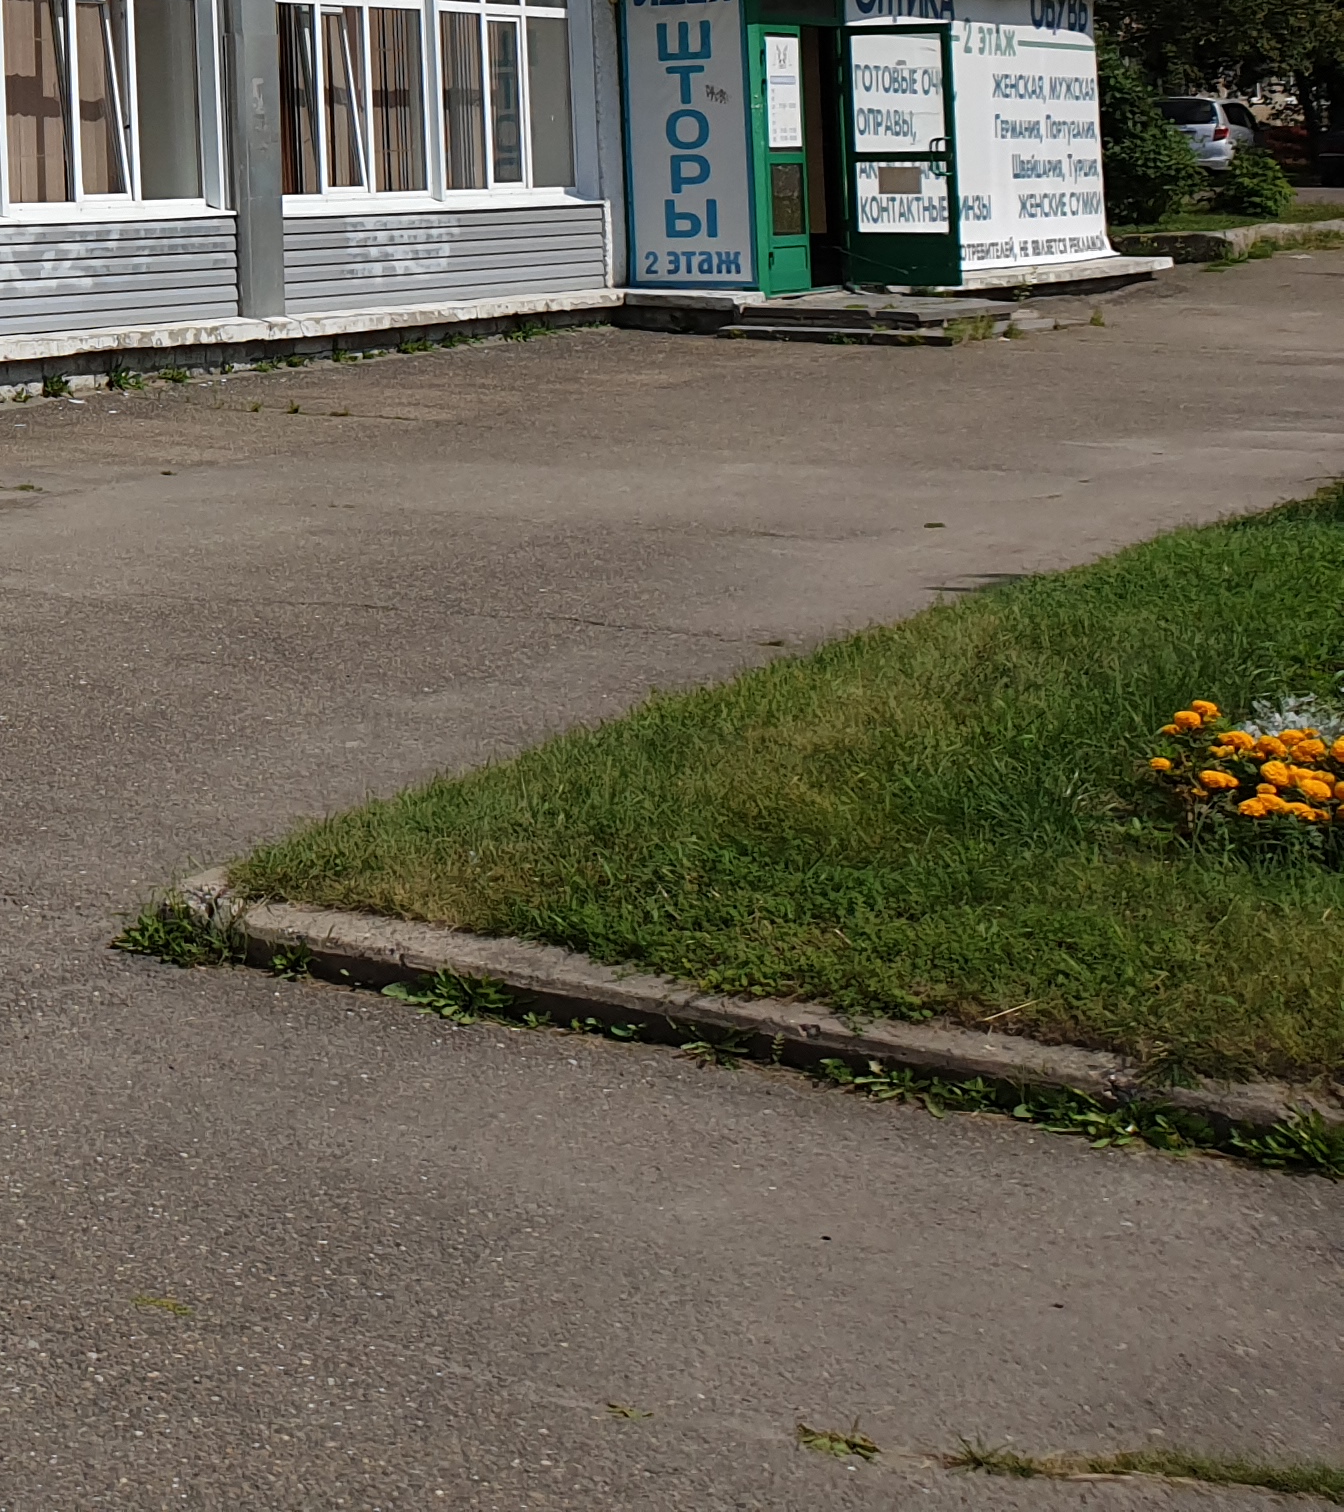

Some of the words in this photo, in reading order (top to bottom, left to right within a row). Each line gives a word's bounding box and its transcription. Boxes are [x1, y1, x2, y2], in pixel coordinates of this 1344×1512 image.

[963, 17, 973, 54] 2
[977, 25, 1016, 57] ЭТАЖ
[854, 63, 919, 95] ГОТОВЫЕ
[992, 73, 1046, 104] ЖЕНСКАЯ,
[1048, 76, 1095, 102] МУЖСКАЯ
[656, 19, 719, 239] ШТОРЫ
[856, 107, 917, 145] ОПРАВЫ,
[860, 195, 948, 225] КОНТАКТНЫЕ
[960, 194, 992, 222] ИНЗЫ
[1018, 192, 1068, 219] ЖЕНСКИЕ
[1069, 191, 1102, 217] СУМКИ
[645, 251, 659, 275] 2
[1019, 240, 1030, 257] НЕ
